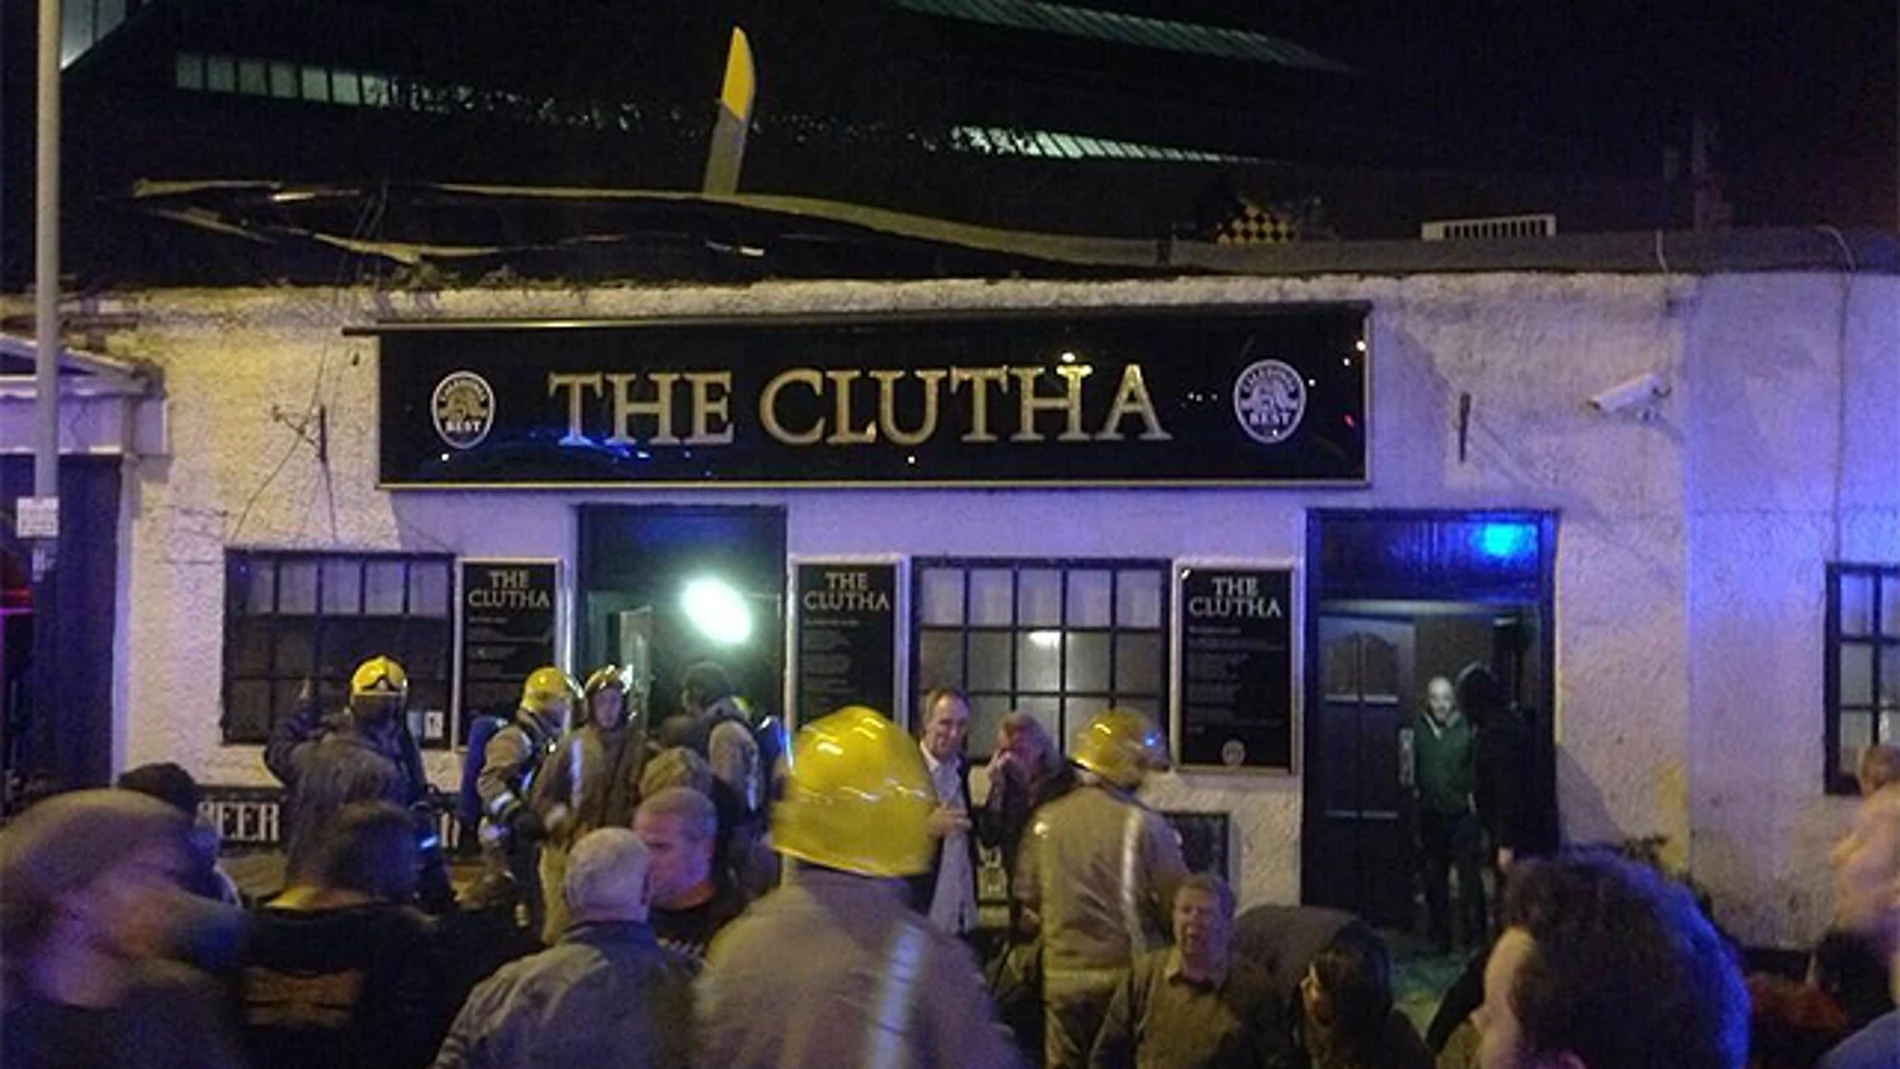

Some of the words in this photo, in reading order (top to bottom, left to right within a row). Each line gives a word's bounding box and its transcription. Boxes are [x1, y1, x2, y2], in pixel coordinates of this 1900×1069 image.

[549, 370, 735, 445] THE
[759, 364, 1173, 446] CLUTHA
[489, 569, 530, 589] THE
[825, 572, 868, 590] THE
[1212, 577, 1259, 596] THE
[467, 590, 550, 608] CLUTHA
[803, 590, 891, 610] CLUTHA
[1188, 597, 1282, 618] CLUTHA
